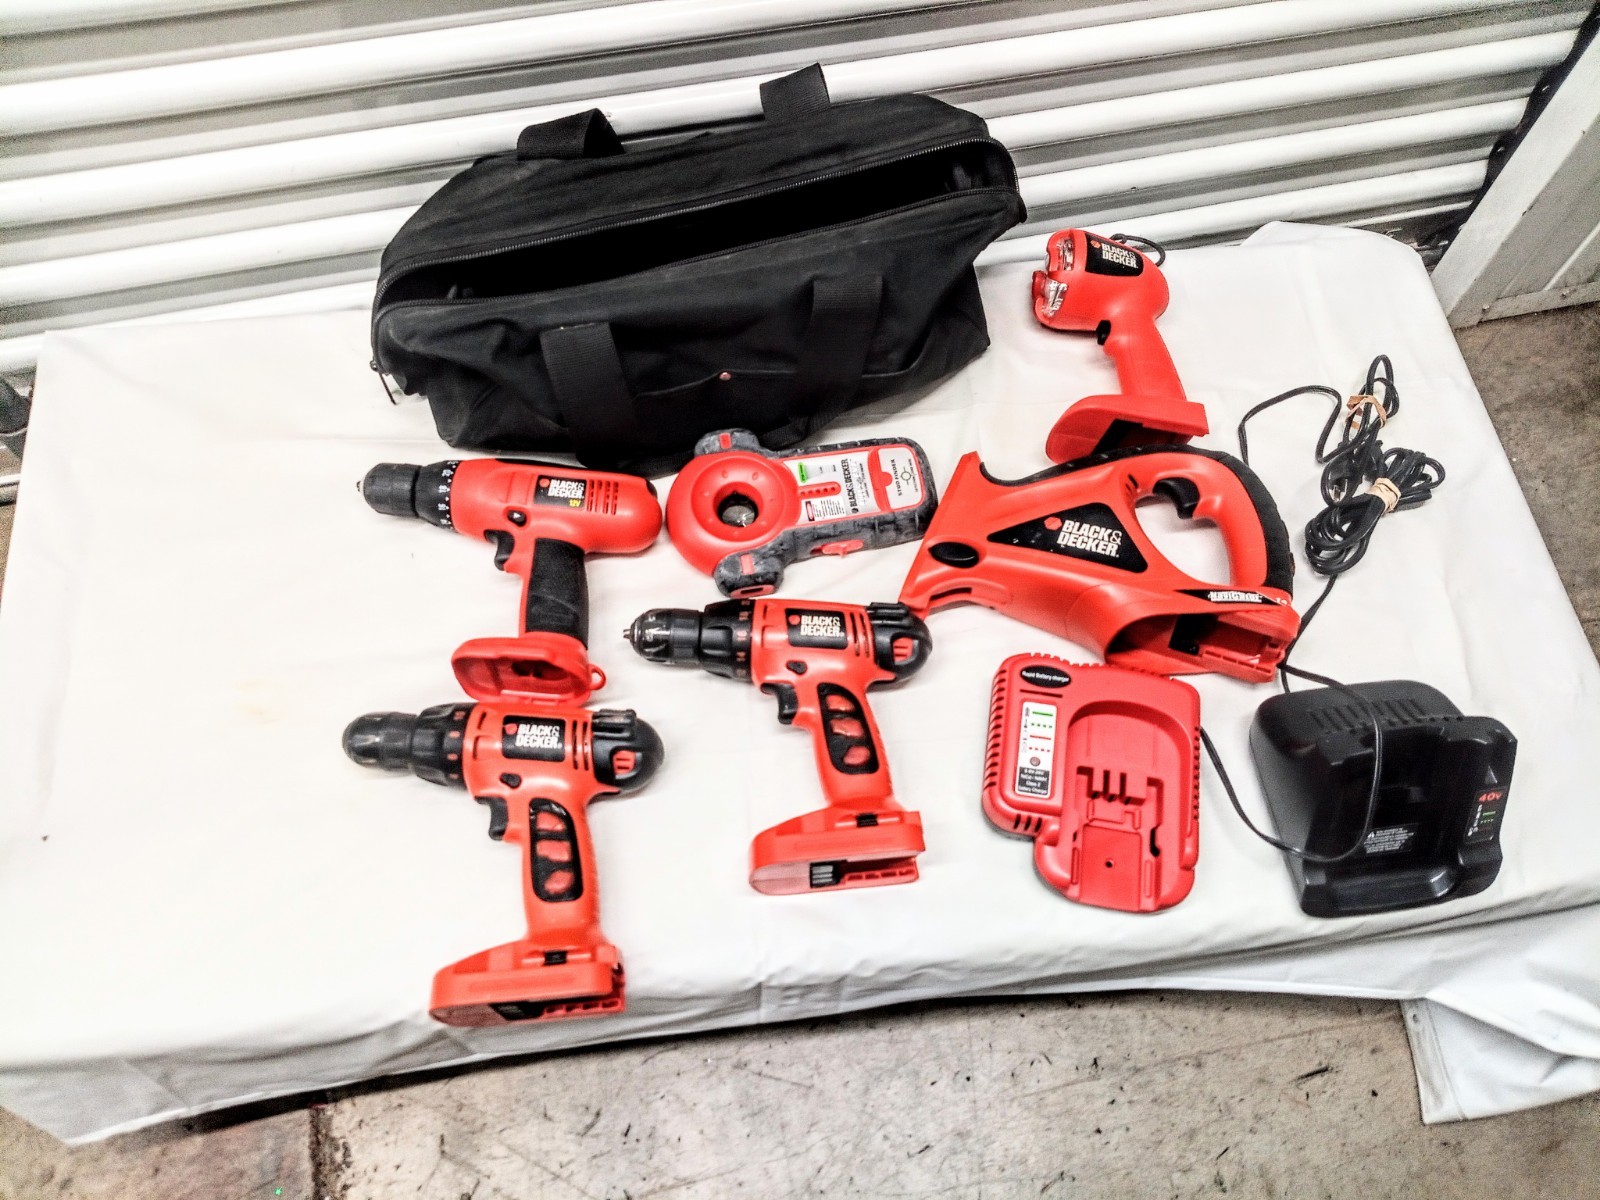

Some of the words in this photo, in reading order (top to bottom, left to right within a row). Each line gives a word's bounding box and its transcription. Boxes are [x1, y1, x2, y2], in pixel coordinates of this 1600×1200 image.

[1101, 242, 1138, 260] BLACK&
[1102, 250, 1138, 268] DECKER
[550, 479, 585, 491] BLACK&
[548, 487, 584, 499] DECKER
[1061, 519, 1122, 545] BLACK&
[1056, 532, 1119, 557] DECKER
[801, 615, 841, 627] BLACK&
[800, 625, 841, 637] DECKER
[518, 724, 560, 737] BLACK&
[515, 734, 559, 749] DECKER
